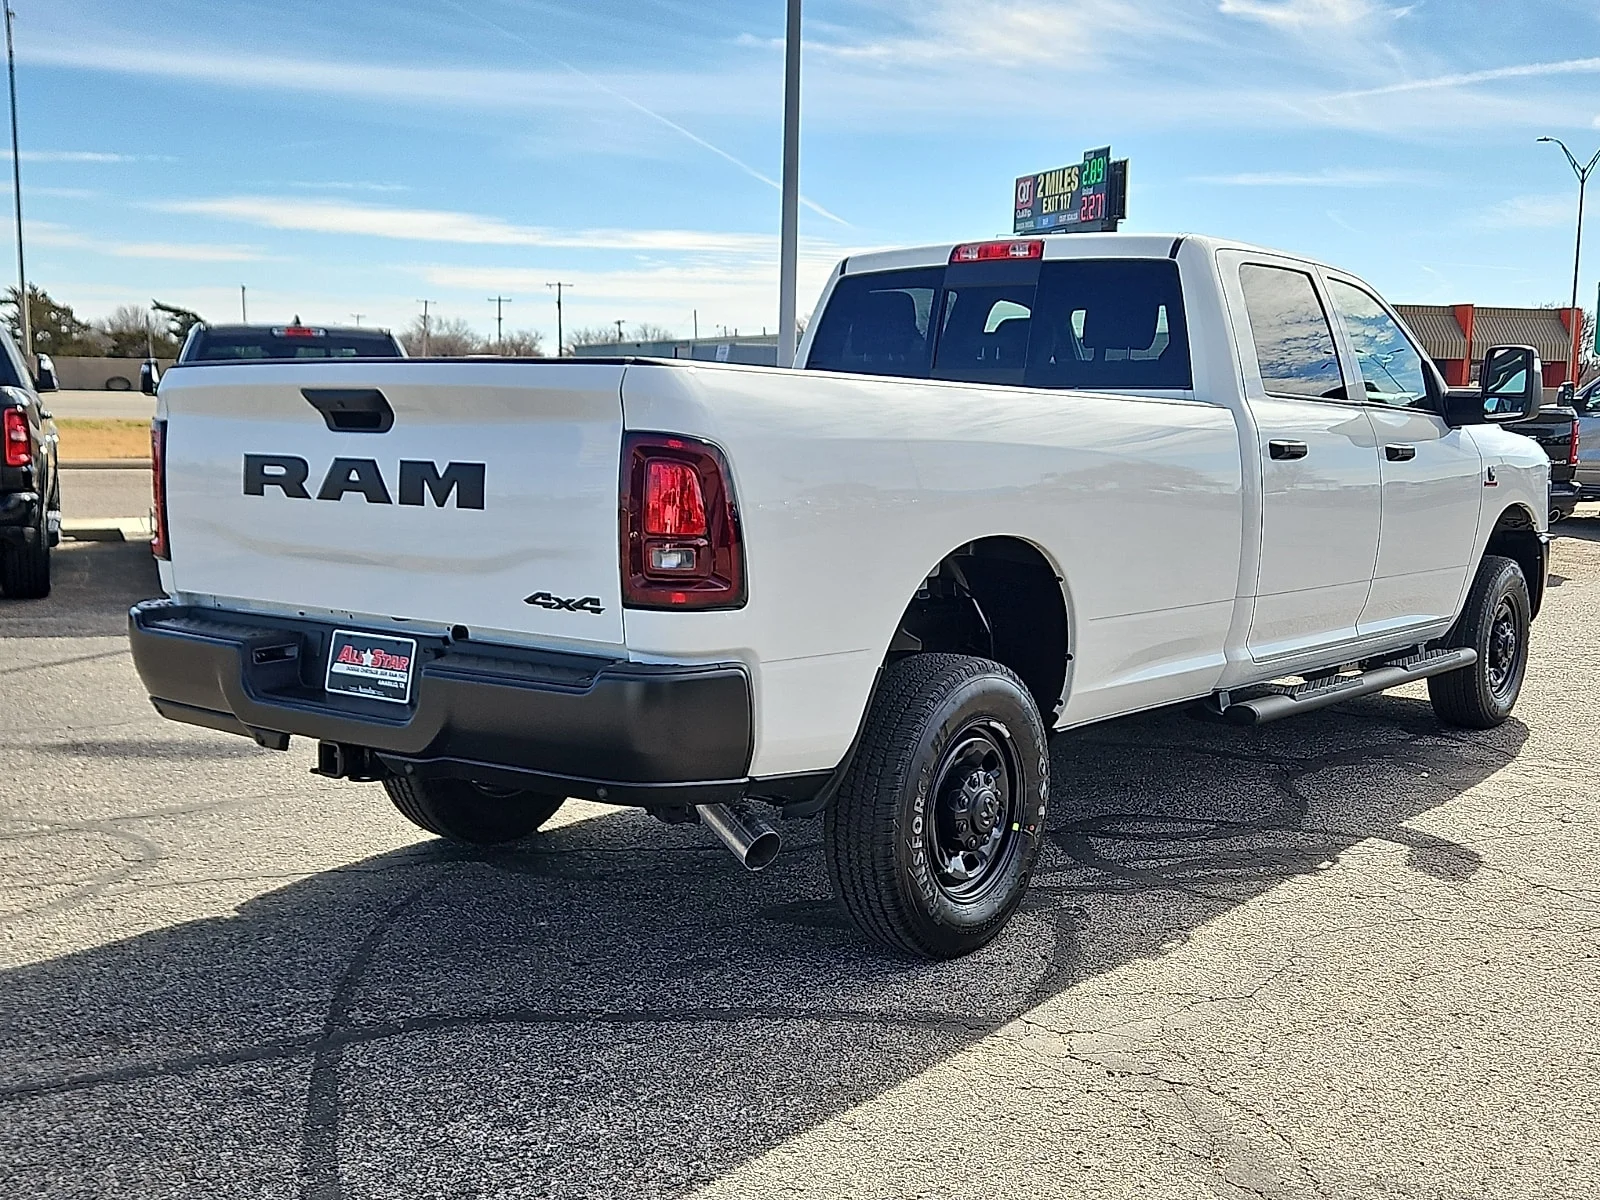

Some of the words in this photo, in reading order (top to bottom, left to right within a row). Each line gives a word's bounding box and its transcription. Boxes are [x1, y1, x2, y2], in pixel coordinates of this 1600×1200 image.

[1018, 181, 1031, 203] QT
[1037, 174, 1045, 198] 2
[1045, 166, 1079, 196] MILES
[1042, 195, 1059, 214] EXIT
[1060, 193, 1072, 211] 117
[243, 453, 487, 511] RAM
[523, 591, 606, 615] 4x4
[372, 649, 410, 672] STAR
